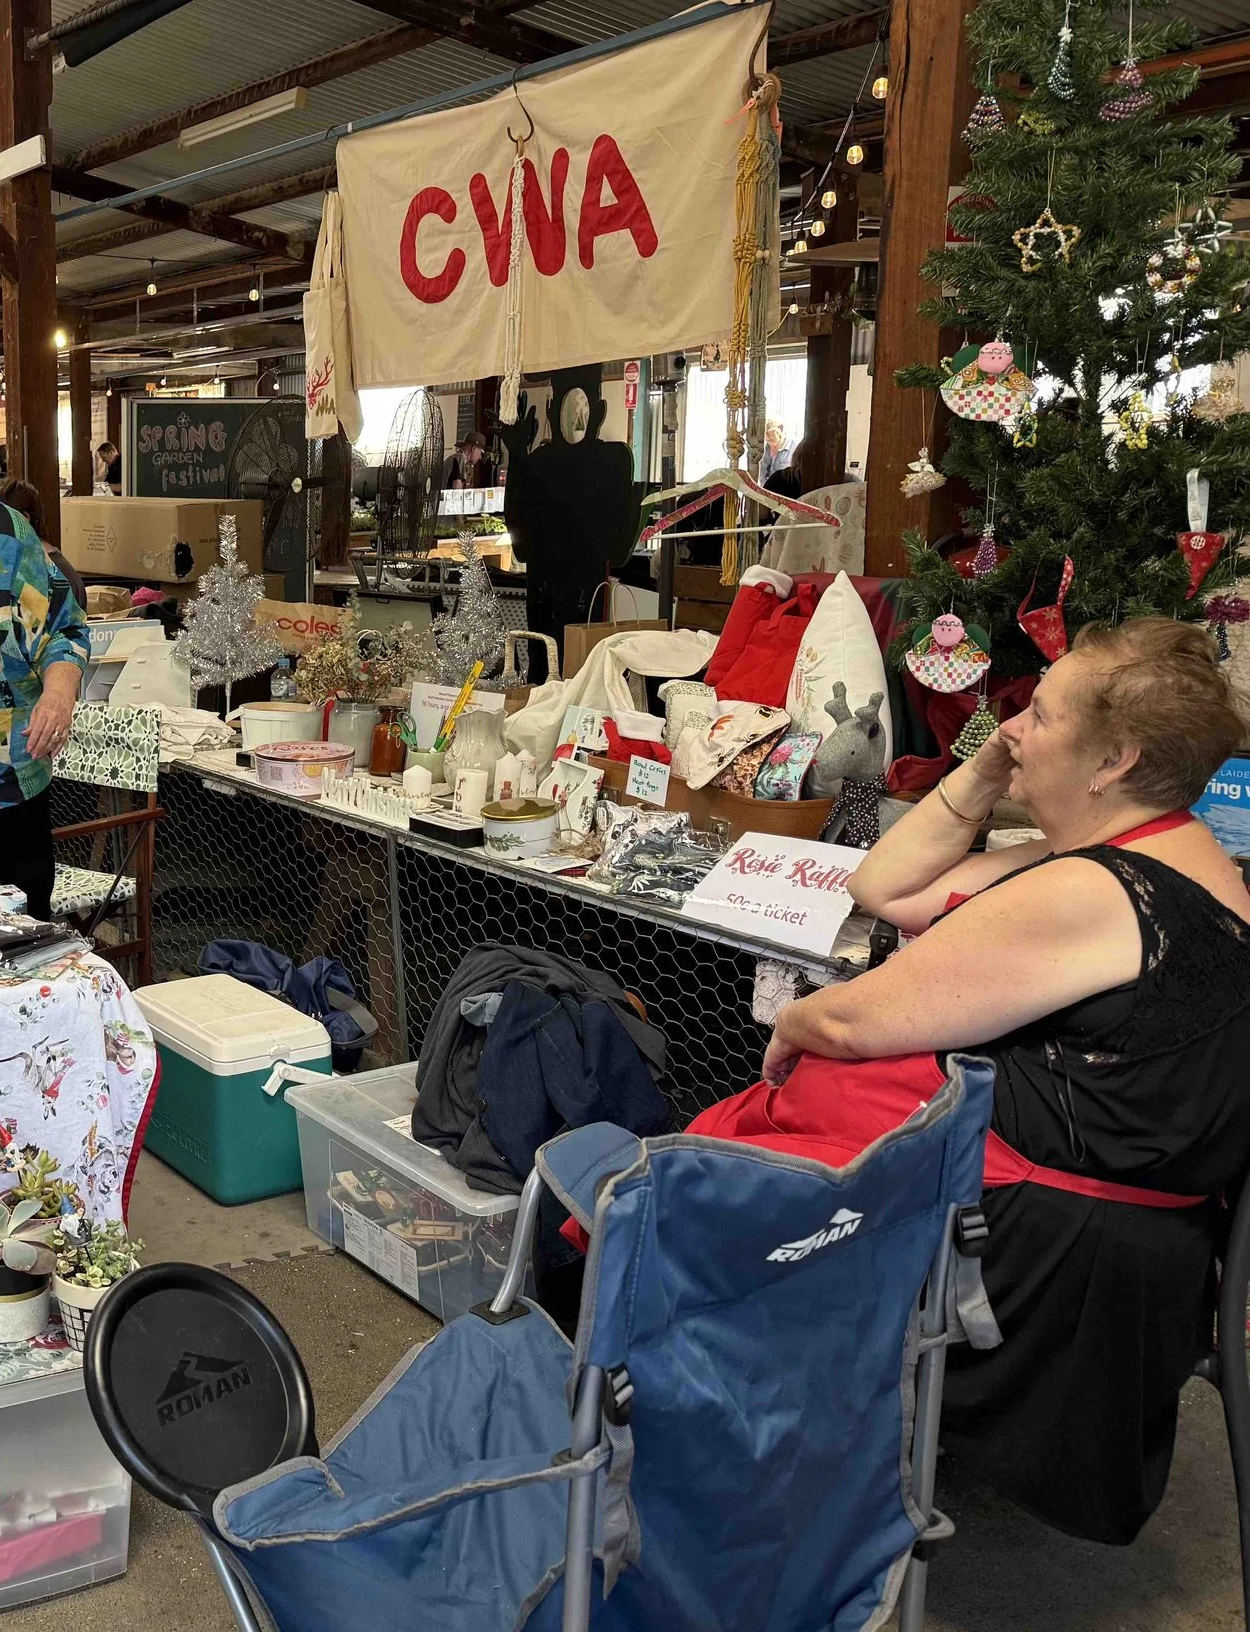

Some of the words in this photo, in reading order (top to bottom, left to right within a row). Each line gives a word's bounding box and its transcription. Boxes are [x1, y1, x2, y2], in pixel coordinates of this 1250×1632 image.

[400, 133, 659, 304] CWA
[138, 420, 228, 453] SPRING
[152, 452, 203, 465] GARDEN
[725, 848, 785, 877] Rosie
[766, 1218, 862, 1262] ROMAN
[157, 1367, 252, 1426] ROMAN
